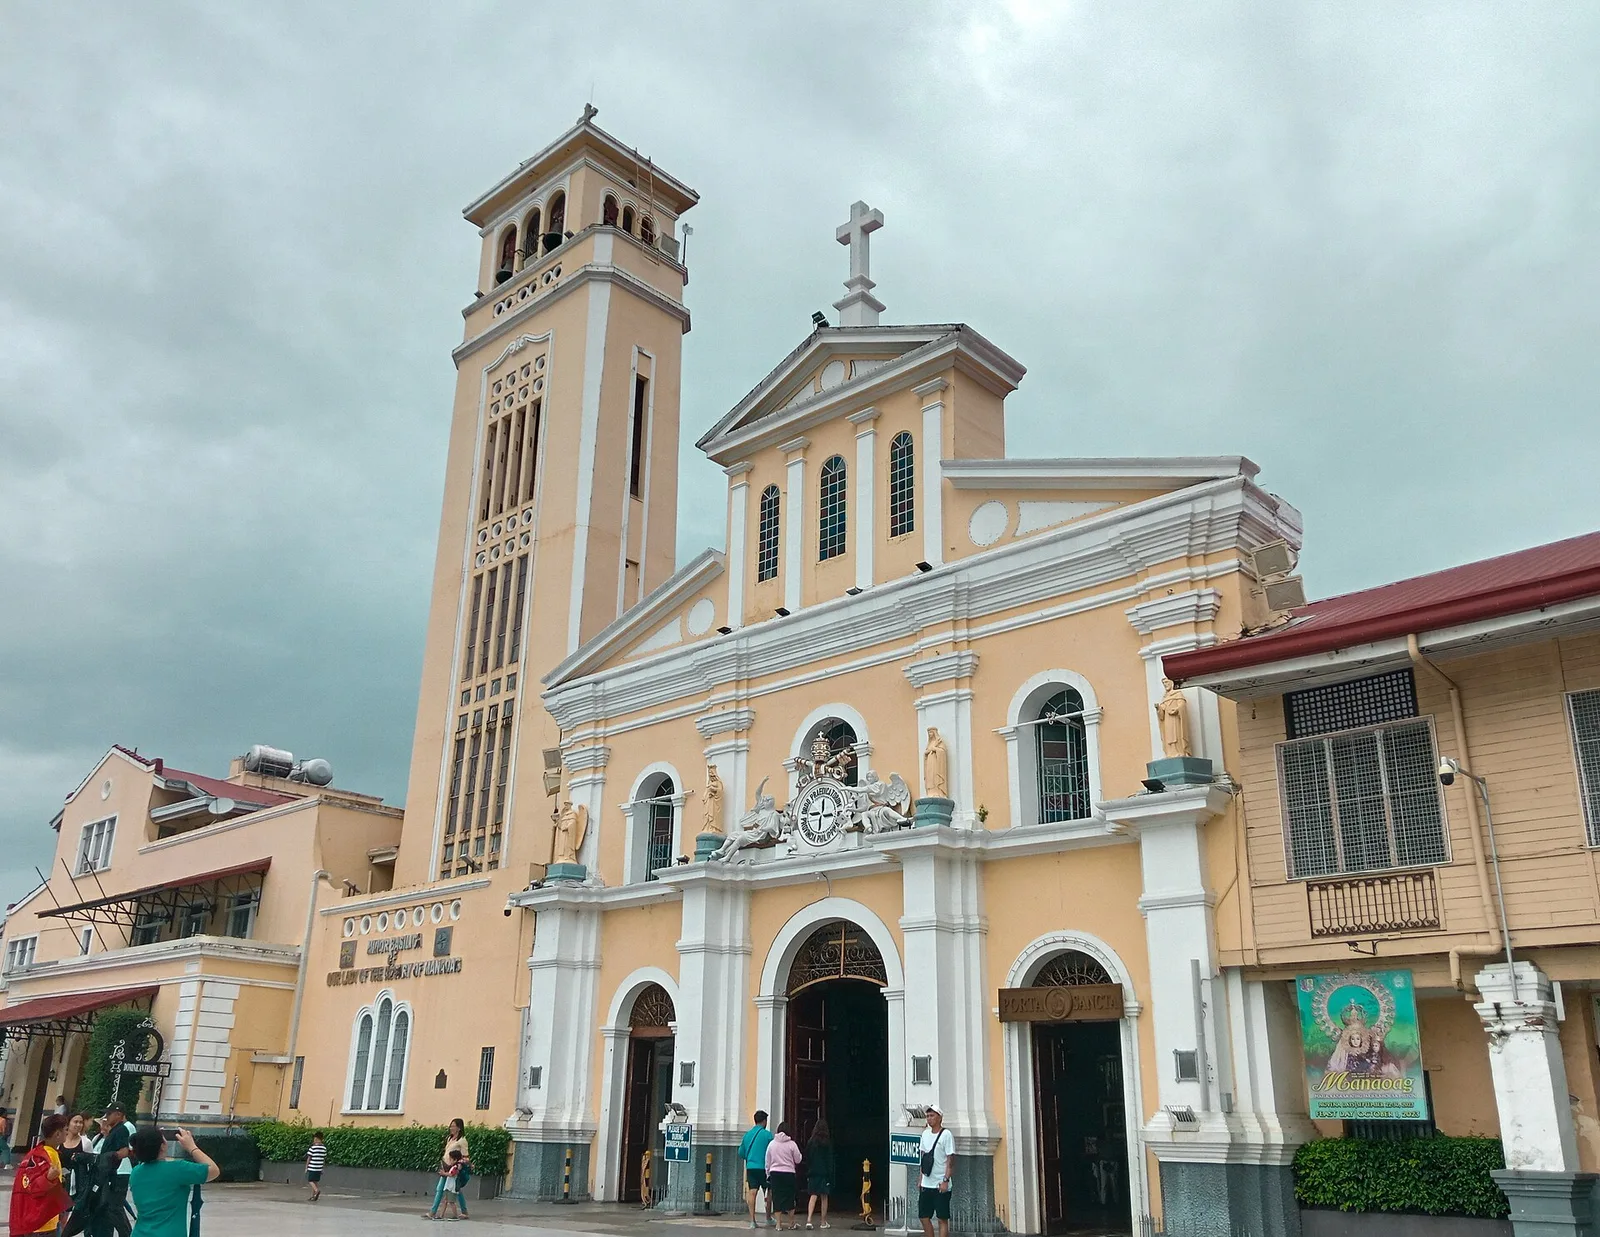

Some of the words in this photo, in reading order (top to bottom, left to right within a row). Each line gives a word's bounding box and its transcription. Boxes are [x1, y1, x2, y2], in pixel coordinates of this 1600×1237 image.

[389, 933, 423, 951] BASILICA
[327, 971, 341, 987] OUR
[341, 969, 359, 985] LADY
[359, 967, 370, 983] OF
[370, 966, 385, 982] THE
[413, 961, 425, 978] OF
[1003, 997, 1045, 1013] PORTA
[1072, 994, 1119, 1012] SANCTA
[1311, 1071, 1415, 1094] Manaoag
[1316, 1110, 1338, 1118] FEAST
[1339, 1110, 1355, 1118] DAY
[1357, 1110, 1394, 1118] OCTOBER
[1401, 1110, 1420, 1118] 2023
[892, 1140, 919, 1158] ENTRANCE
